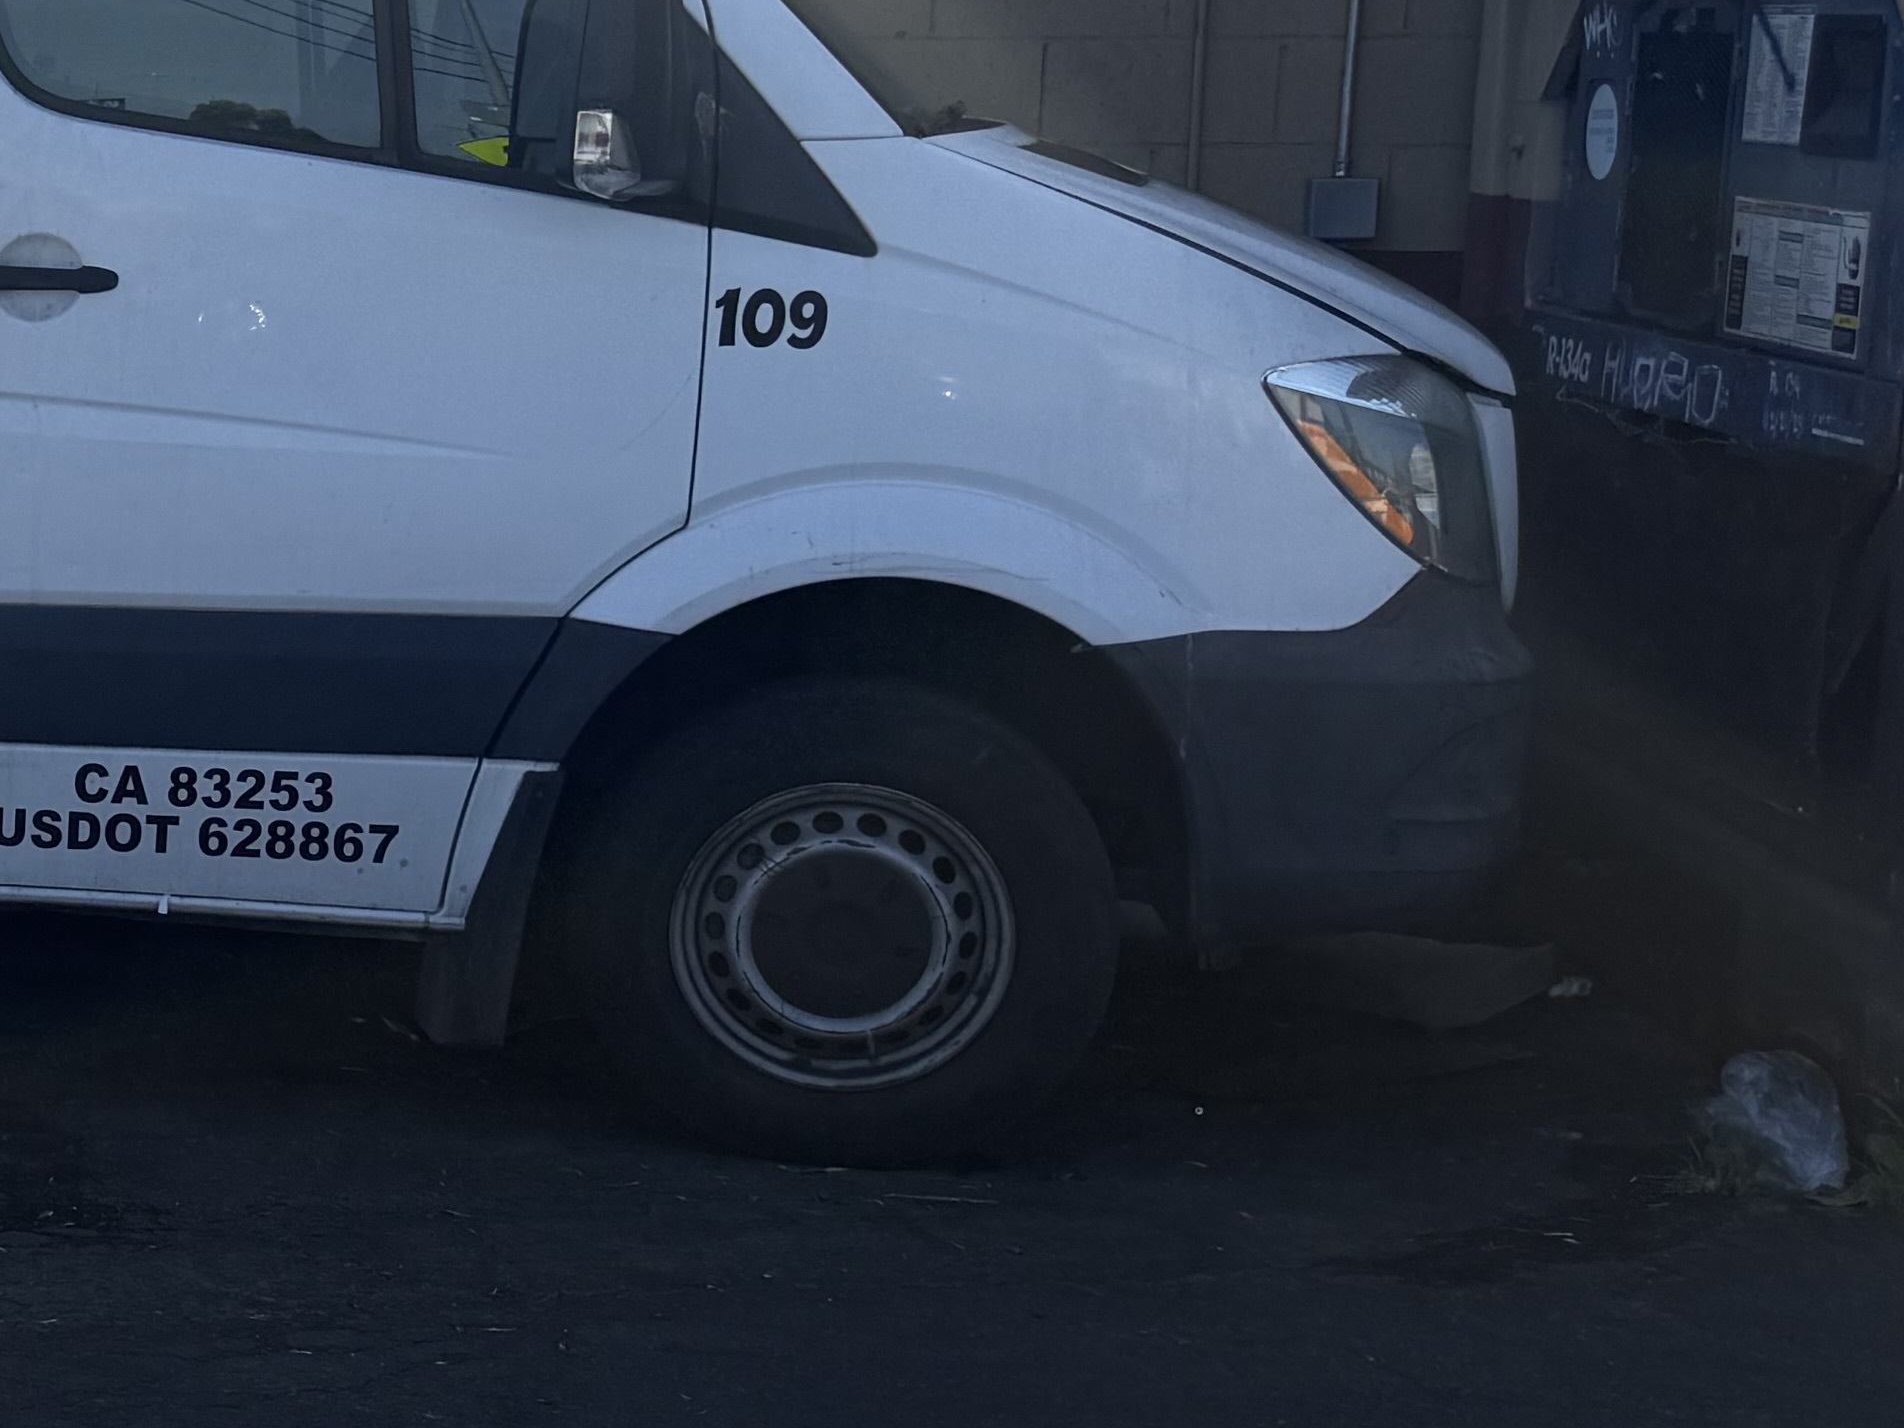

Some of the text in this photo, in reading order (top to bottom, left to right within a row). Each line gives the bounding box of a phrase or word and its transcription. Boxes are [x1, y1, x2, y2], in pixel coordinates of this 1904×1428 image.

[715, 287, 828, 349] 109
[74, 762, 334, 813] CA 83253
[198, 817, 400, 864] 628867
